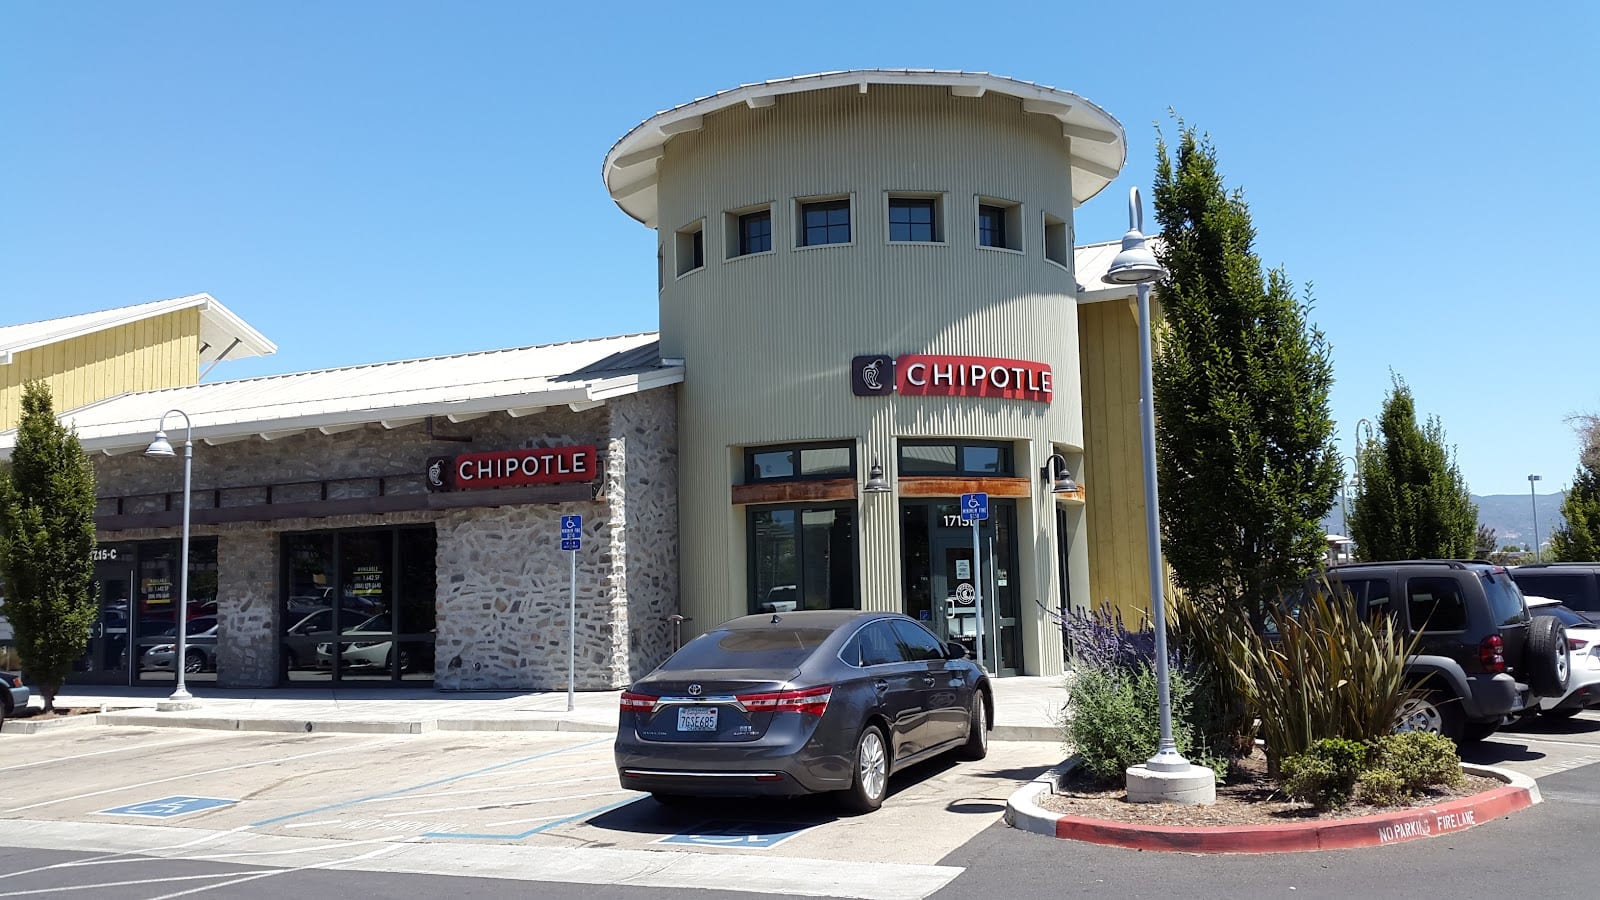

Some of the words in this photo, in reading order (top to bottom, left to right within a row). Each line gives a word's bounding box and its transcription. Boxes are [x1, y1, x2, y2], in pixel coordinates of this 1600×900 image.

[907, 363, 1053, 393] CHIPOTLE
[459, 452, 586, 480] CHIPOTLE
[943, 515, 974, 527] 1715
[1379, 826, 1395, 842] NO
[1437, 813, 1458, 831] FIRE
[1457, 811, 1476, 826] LANE
